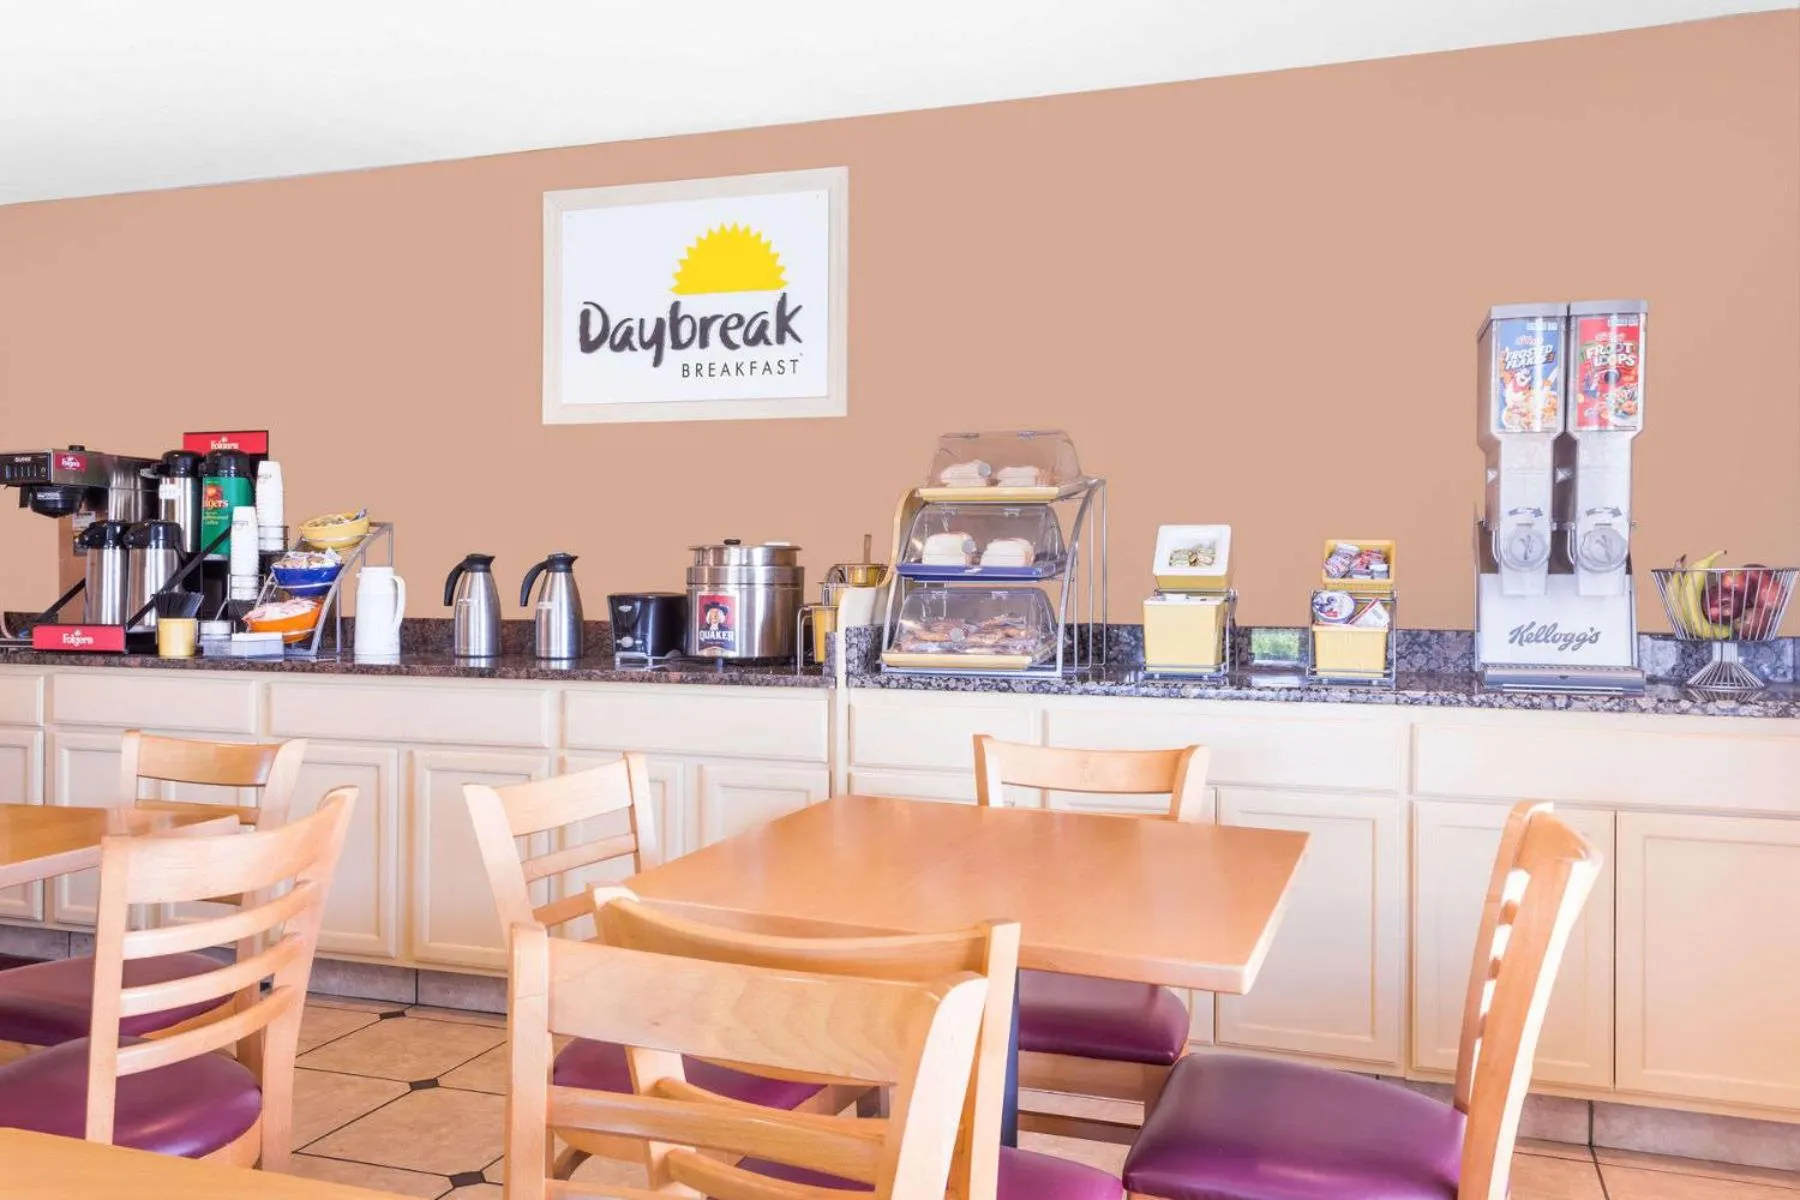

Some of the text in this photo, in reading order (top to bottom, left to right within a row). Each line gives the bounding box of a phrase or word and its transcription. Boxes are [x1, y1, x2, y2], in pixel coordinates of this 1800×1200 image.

[579, 292, 803, 368] Daybreak
[1586, 342, 1634, 359] FROOT
[681, 359, 799, 379] BREAKFAST
[1593, 353, 1637, 367] LOOPS
[699, 630, 734, 642] QUAKER
[1508, 620, 1602, 652] Kellogg's
